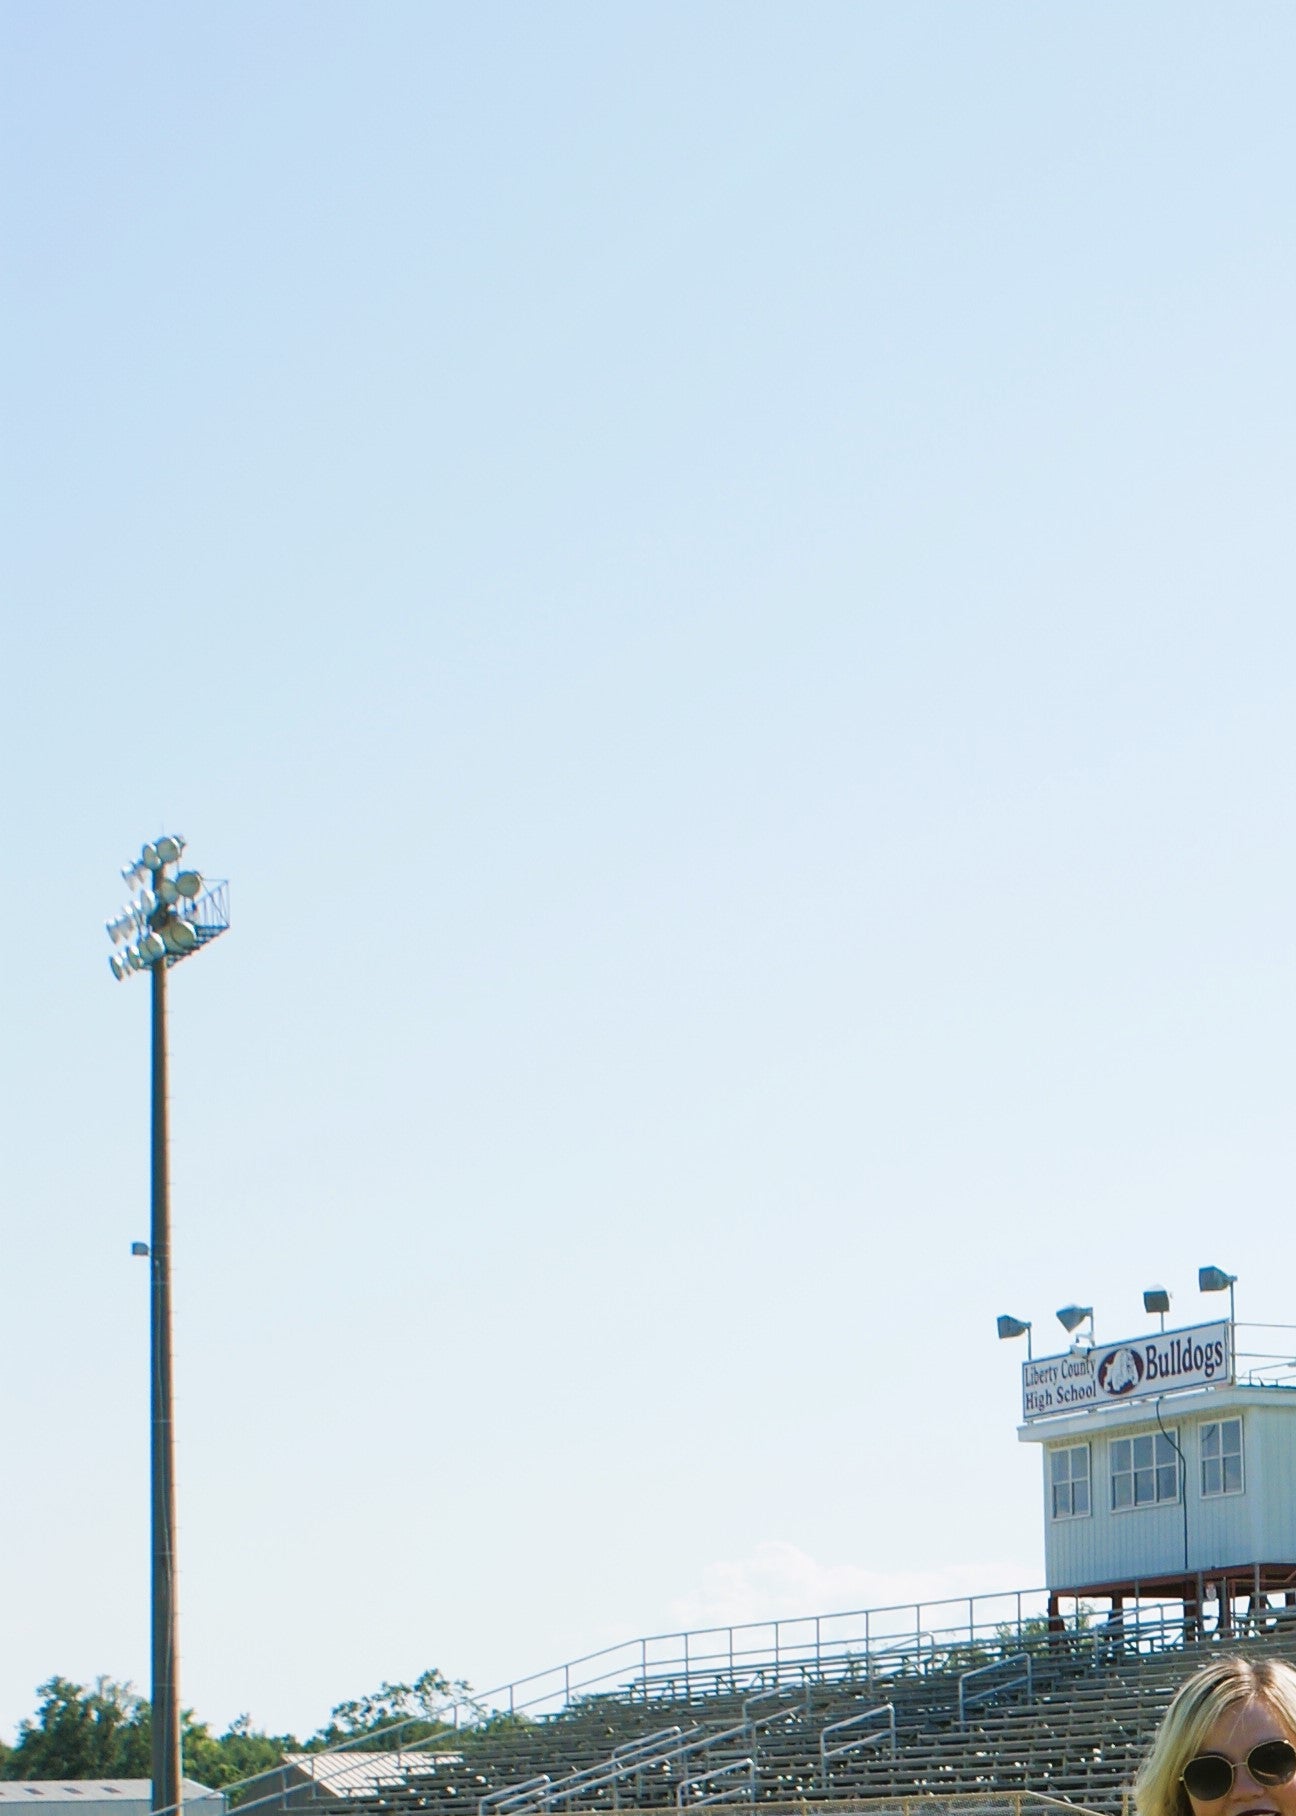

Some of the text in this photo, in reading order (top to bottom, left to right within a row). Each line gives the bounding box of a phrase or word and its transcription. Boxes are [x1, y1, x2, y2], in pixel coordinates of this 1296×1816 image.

[1025, 1359, 1096, 1387] Liberty County
[1145, 1337, 1223, 1380] Bulldogs
[1025, 1380, 1097, 1411] High School
